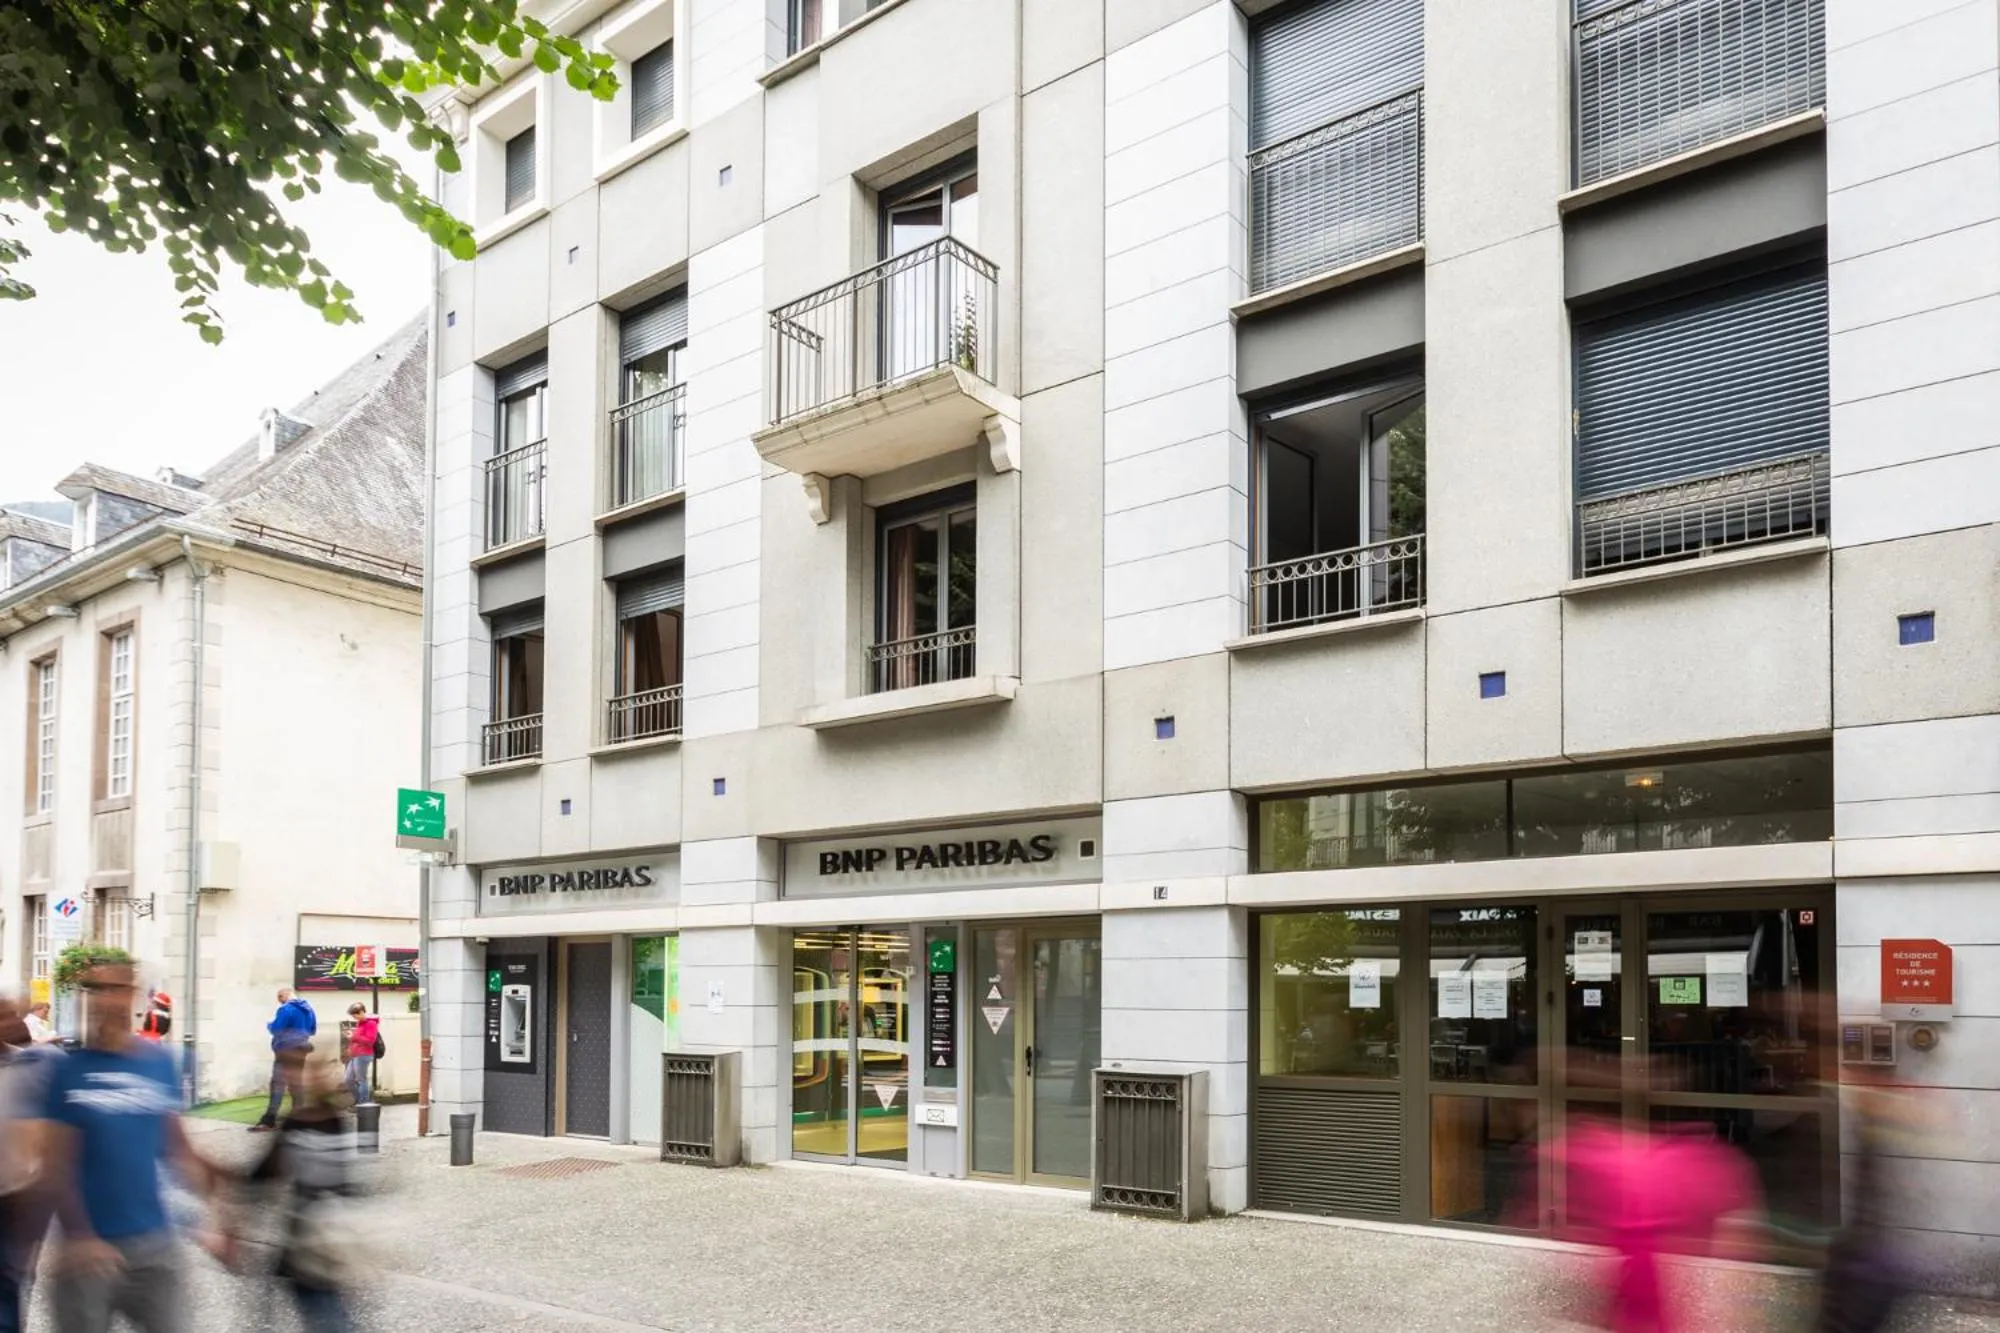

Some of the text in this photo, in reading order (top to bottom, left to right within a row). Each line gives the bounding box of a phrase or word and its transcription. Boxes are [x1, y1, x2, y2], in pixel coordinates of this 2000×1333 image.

[819, 835, 1058, 876] BNP PARIBAS
[499, 865, 652, 896] BNP PARIBAS
[1893, 951, 1938, 960] RÉSIDENCE
[1909, 960, 1921, 968] DE
[1896, 968, 1936, 976] TOURISME
